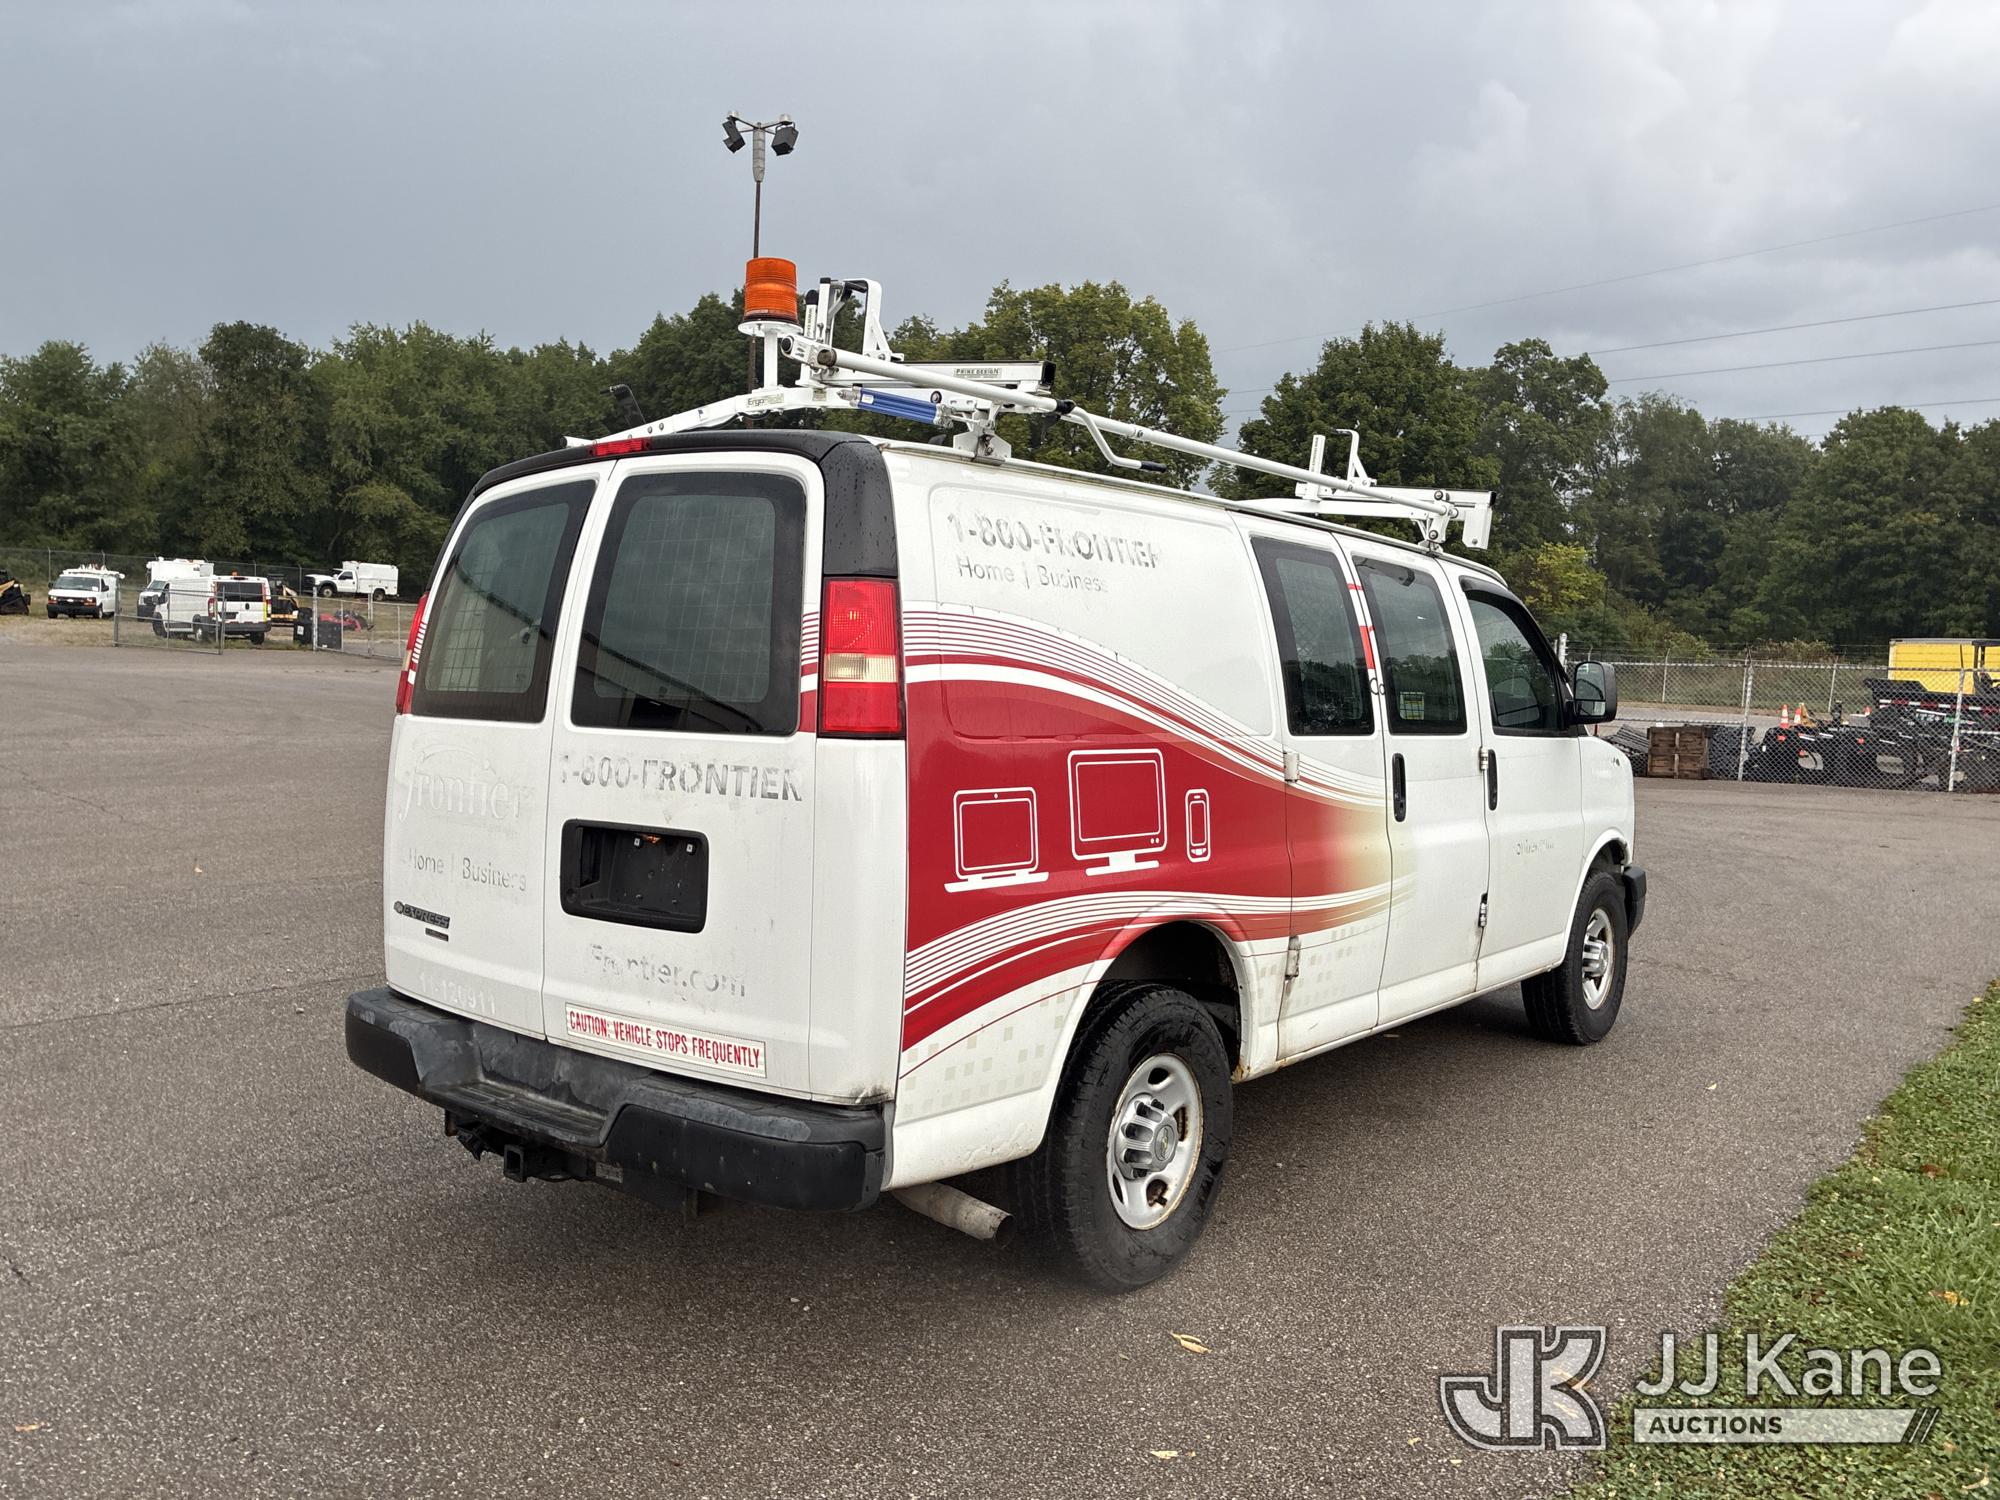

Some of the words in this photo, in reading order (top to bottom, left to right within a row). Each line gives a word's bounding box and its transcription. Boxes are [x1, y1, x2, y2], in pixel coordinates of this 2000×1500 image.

[957, 555, 1015, 584] Home
[408, 847, 445, 874] Home
[402, 903, 450, 930] EXPRESS
[569, 1010, 611, 1038] CAUTION:
[613, 1020, 653, 1048] VEHICLE
[655, 1029, 689, 1055] STOPS
[692, 1037, 761, 1069] FREQUENTLY
